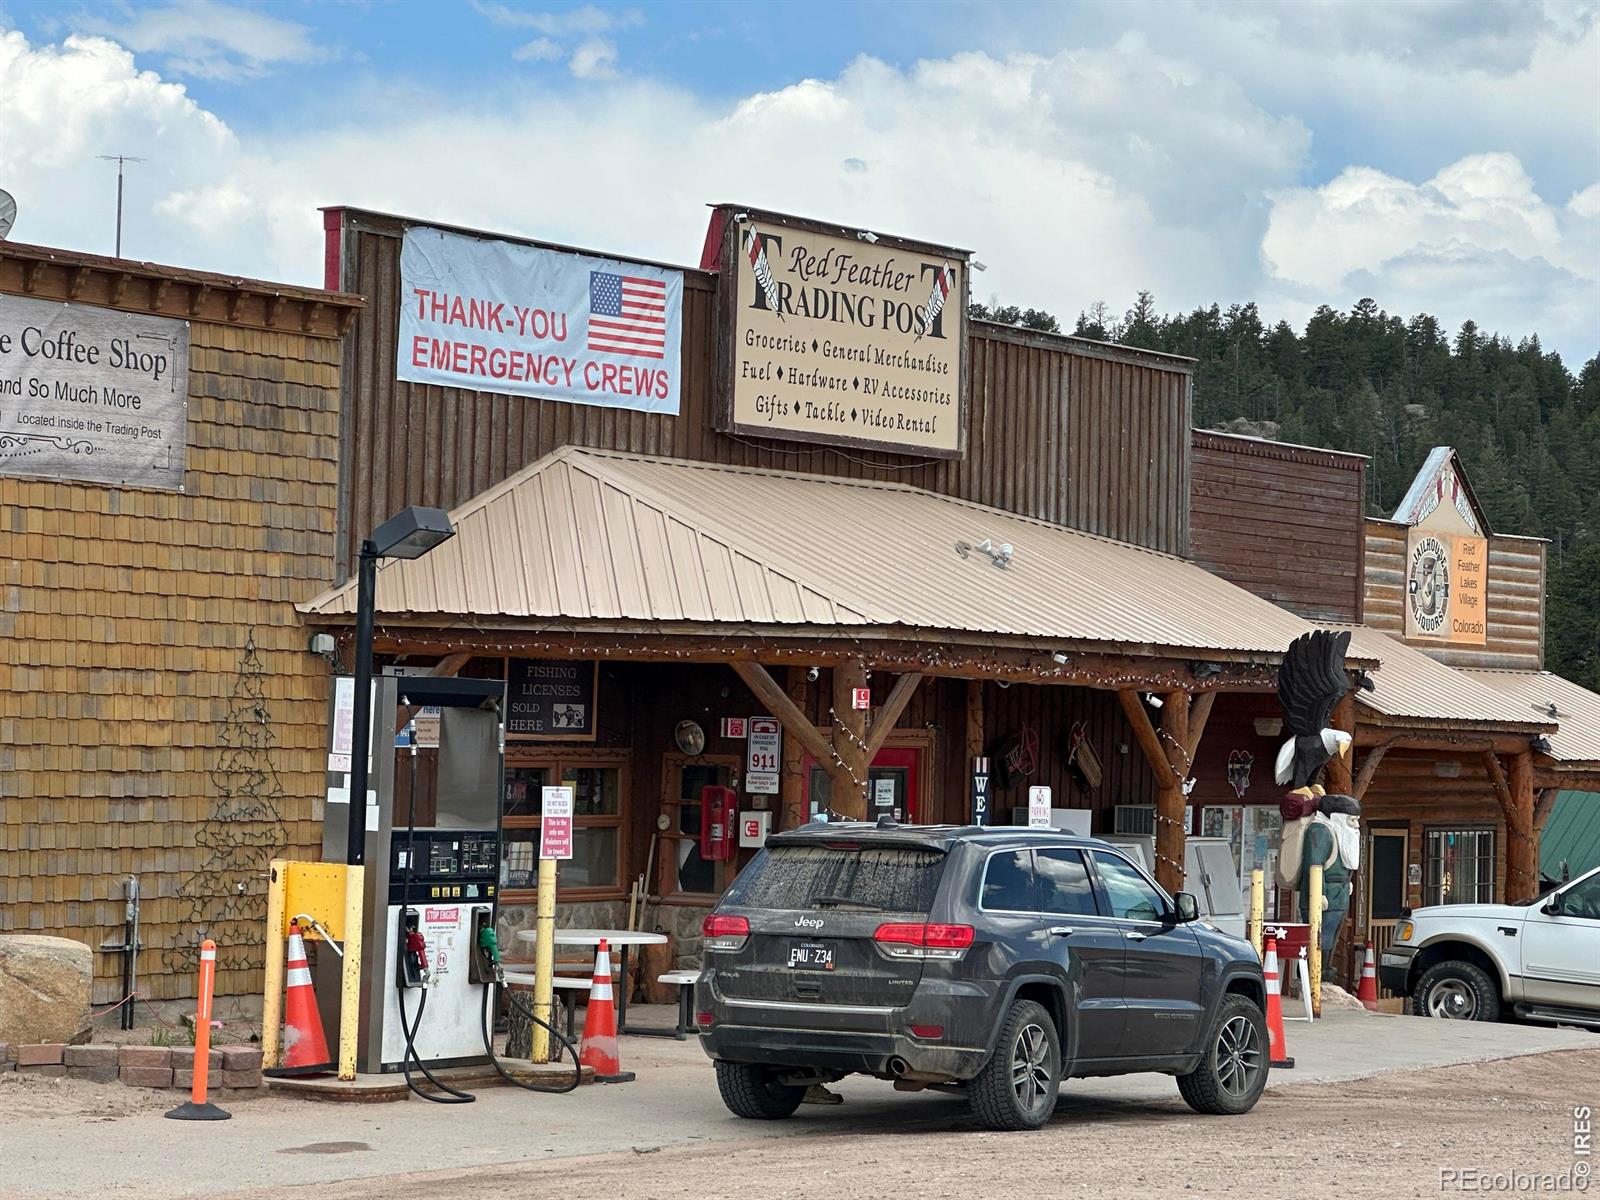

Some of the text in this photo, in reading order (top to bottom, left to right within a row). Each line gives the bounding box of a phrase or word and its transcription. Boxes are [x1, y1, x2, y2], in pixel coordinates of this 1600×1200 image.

[788, 246, 915, 292] Red Feather
[743, 230, 956, 339] TRADING POST
[414, 288, 567, 341] THANK-YOU
[21, 326, 100, 365] Coffee
[110, 338, 167, 380] Shop
[746, 328, 948, 375] Groceries General Merchandise
[412, 335, 668, 399] EMERGENCY CREWS
[29, 378, 49, 399] So
[55, 381, 97, 404] Much
[104, 387, 141, 410] More
[742, 361, 951, 405] Fuel Hardware RV Accessories
[17, 412, 161, 439] Located inside the Trading Post
[756, 395, 936, 434] Gifts Tackle Video Rental
[1413, 538, 1447, 568] JAILHOUSE
[1463, 543, 1475, 556] Red
[1457, 559, 1480, 572] Feather
[1460, 576, 1477, 590] Lakes
[1458, 592, 1478, 608] Village
[1414, 607, 1444, 631] LIQUORS
[1453, 618, 1484, 635] Colorado
[527, 666, 577, 679] FISHING
[522, 683, 580, 697] LICENSES
[512, 702, 540, 713] SOLD
[509, 719, 544, 731] HERE
[752, 753, 775, 768] 911
[794, 916, 824, 930] Jeep
